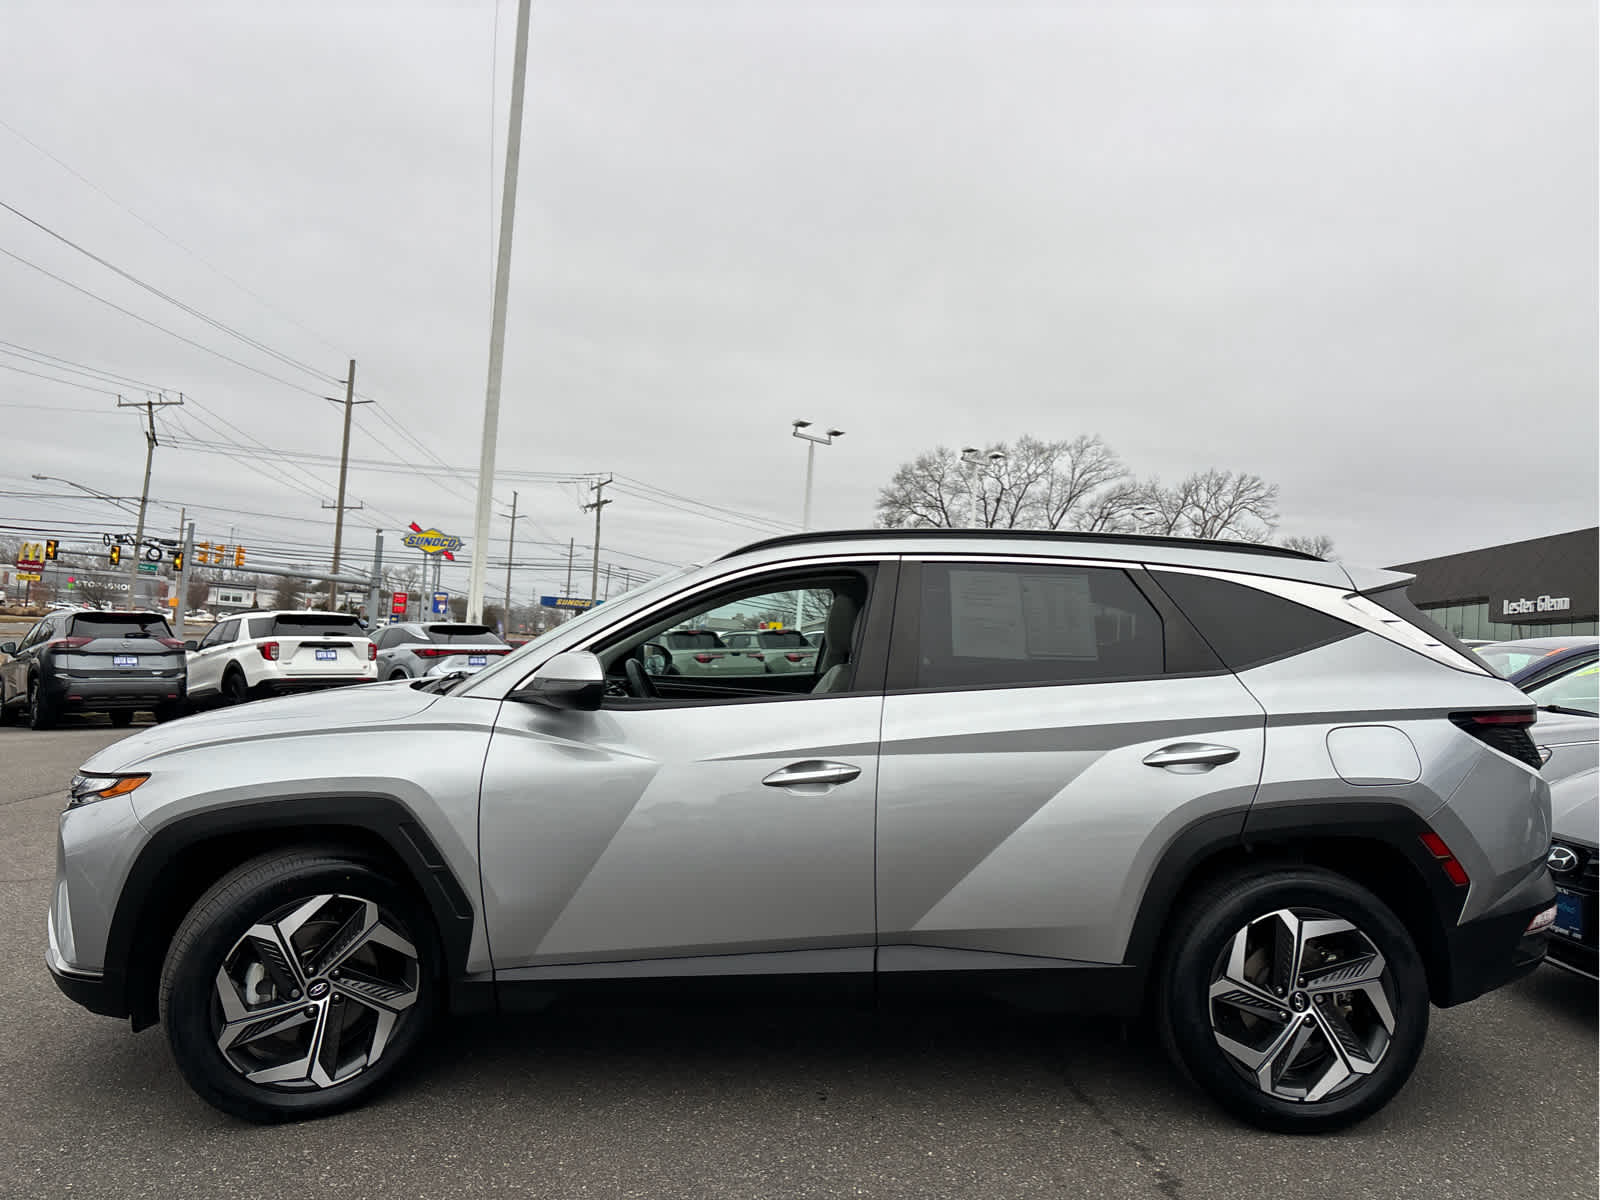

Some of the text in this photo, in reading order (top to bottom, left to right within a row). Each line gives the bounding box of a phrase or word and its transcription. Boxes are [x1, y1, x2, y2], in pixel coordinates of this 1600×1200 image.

[408, 535, 456, 547] SUNOCO
[556, 599, 591, 607] SUNOCO
[1503, 595, 1569, 614] Lester Glenn
